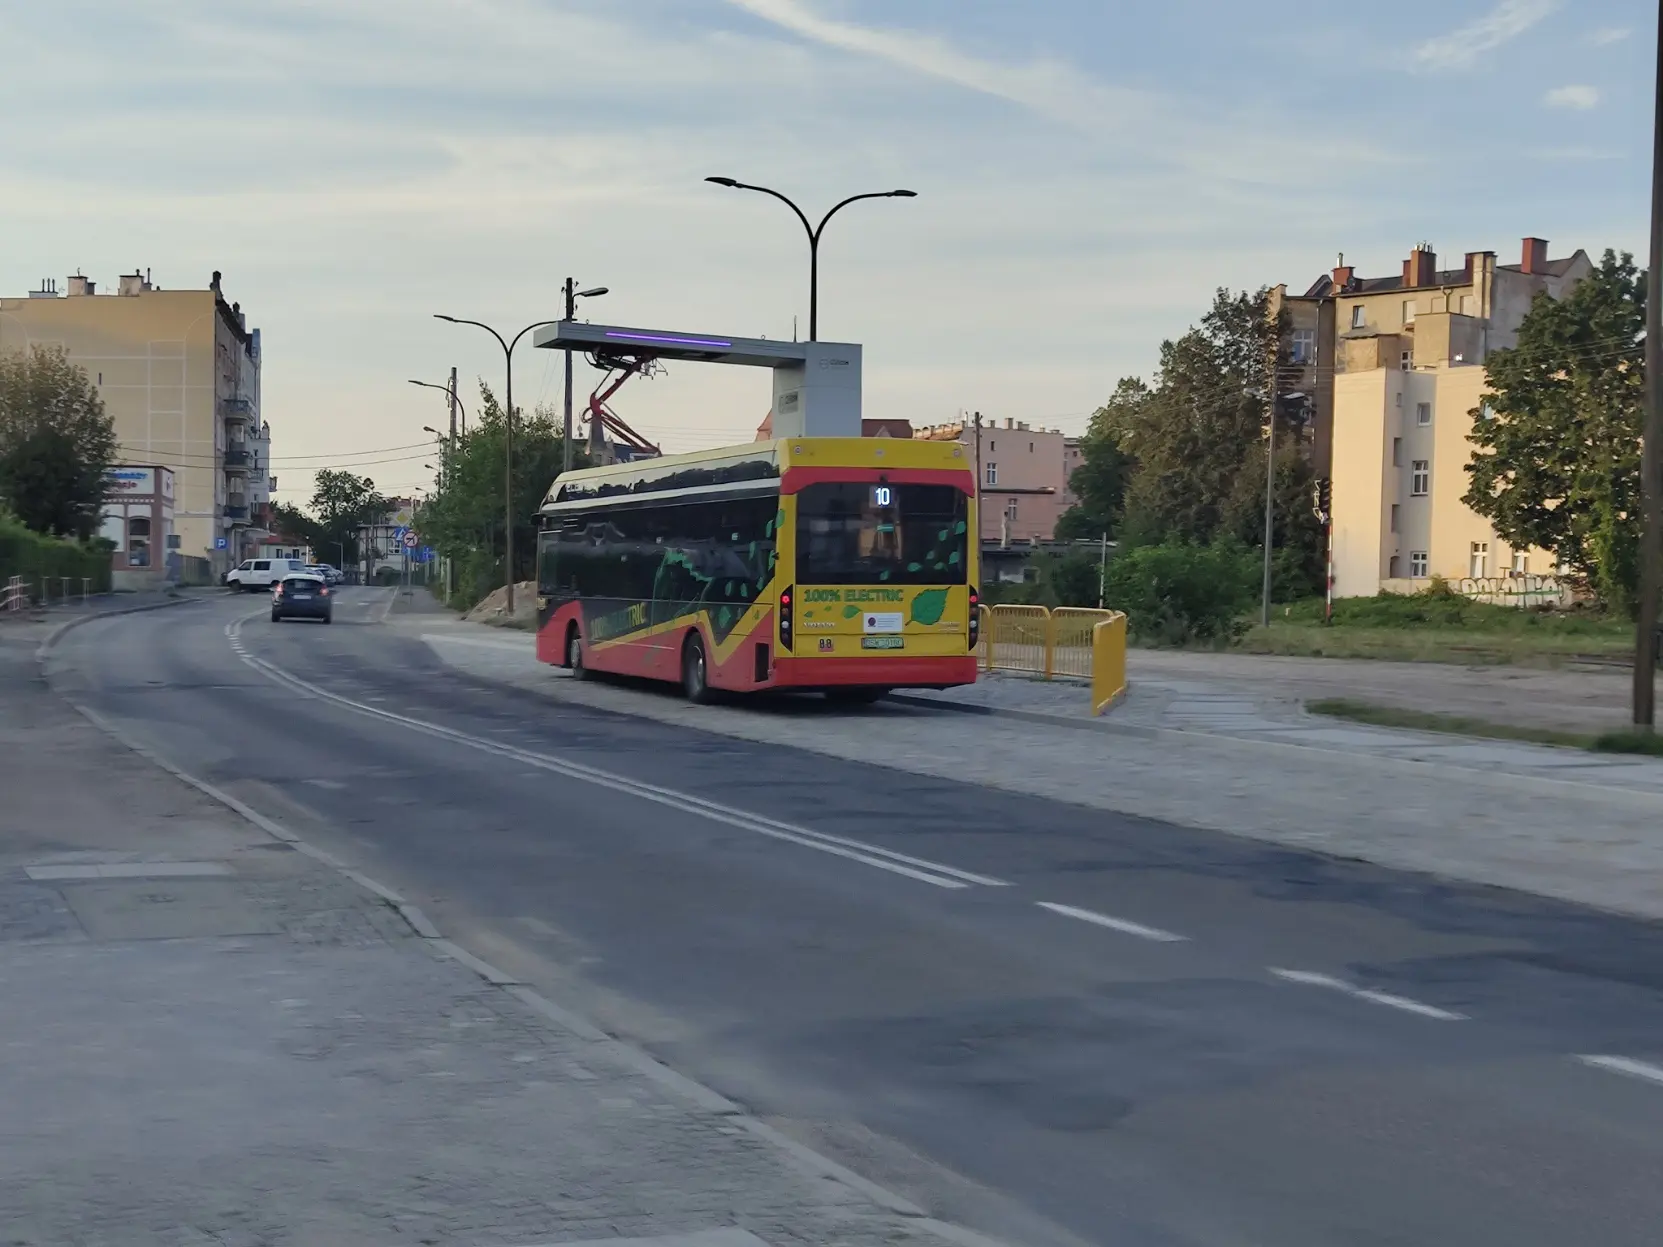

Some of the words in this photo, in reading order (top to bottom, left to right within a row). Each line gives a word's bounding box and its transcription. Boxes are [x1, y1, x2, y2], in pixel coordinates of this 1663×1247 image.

[875, 487, 890, 505] 10
[804, 588, 841, 602] 100%
[844, 588, 904, 602] ELECTRIC
